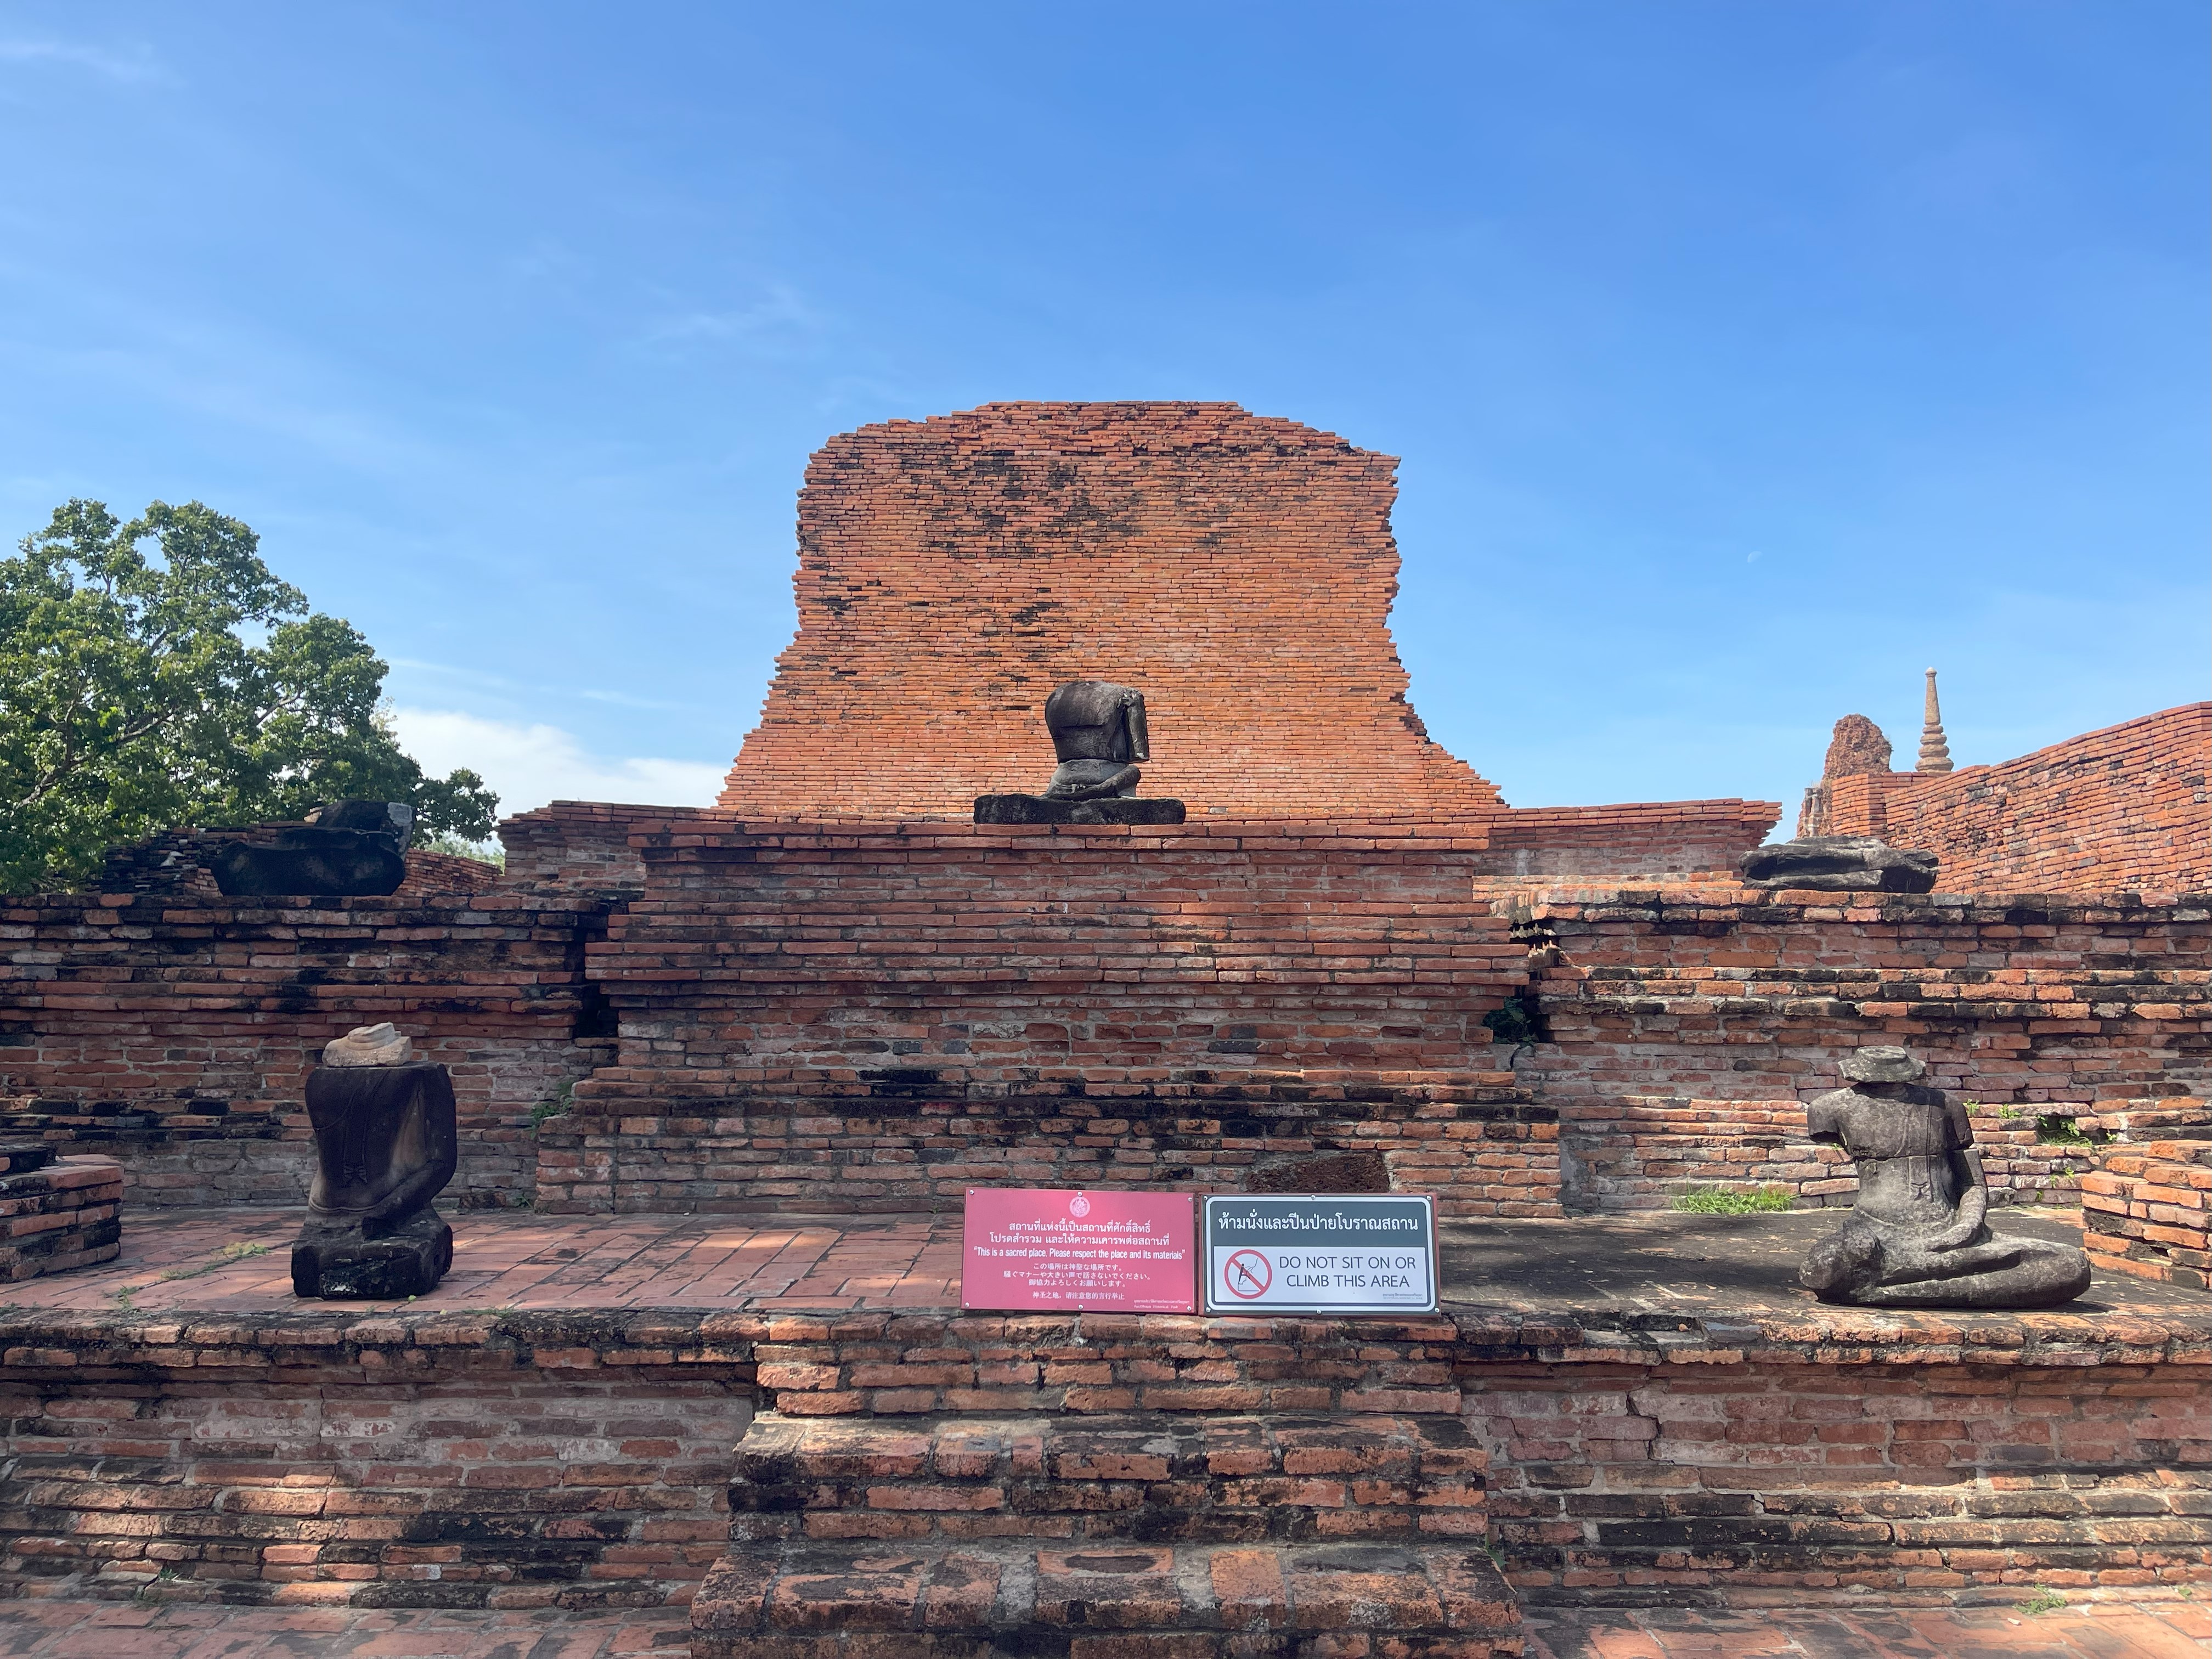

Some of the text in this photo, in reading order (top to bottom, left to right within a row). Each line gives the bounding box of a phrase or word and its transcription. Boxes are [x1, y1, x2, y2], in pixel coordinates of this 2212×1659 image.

[1009, 1218, 1150, 1234] สถานที่แห่งนี้เป็นสถานที่ศักดิ์สิทธิ์
[1218, 1209, 1418, 1231] ห้ามนั่งและปีนป่ายโบราณสถาน
[990, 1232, 1170, 1246] โปรดสำรวม และให้ความเคารพต่อสถานที่
[992, 1248, 997, 1256] is
[1006, 1248, 1027, 1257] sacred
[1029, 1248, 1047, 1259] place.
[1049, 1248, 1070, 1257] Please
[1073, 1249, 1096, 1260] respect
[1098, 1249, 1109, 1259] the
[1110, 1250, 1127, 1260] place
[1130, 1250, 1141, 1259] and
[1279, 1256, 1416, 1269] DO NOT SIT ON OR
[1286, 1275, 1410, 1288] CLIMB THIS AREA
